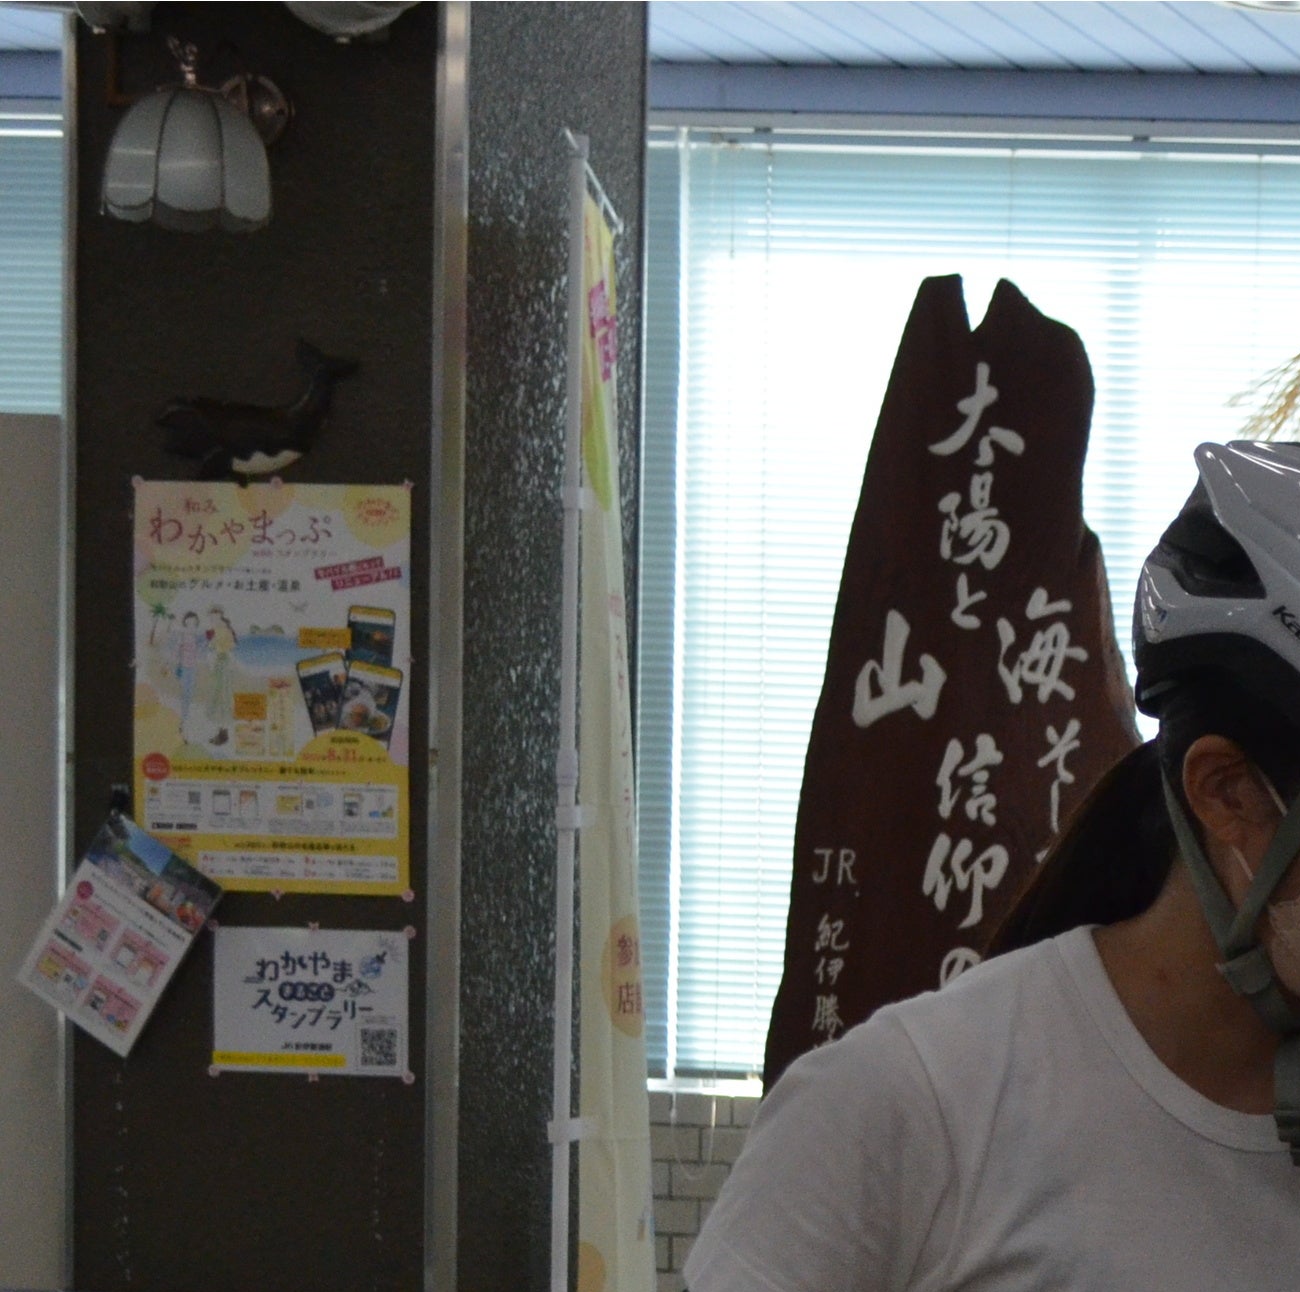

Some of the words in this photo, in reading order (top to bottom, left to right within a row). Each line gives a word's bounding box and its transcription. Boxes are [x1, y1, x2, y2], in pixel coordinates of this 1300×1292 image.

[150, 508, 333, 554] わかやまっぷ
[851, 609, 947, 728] 山
[812, 847, 859, 888] JR
[256, 950, 353, 984] わかやま
[252, 989, 374, 1030] スタンプラリー
